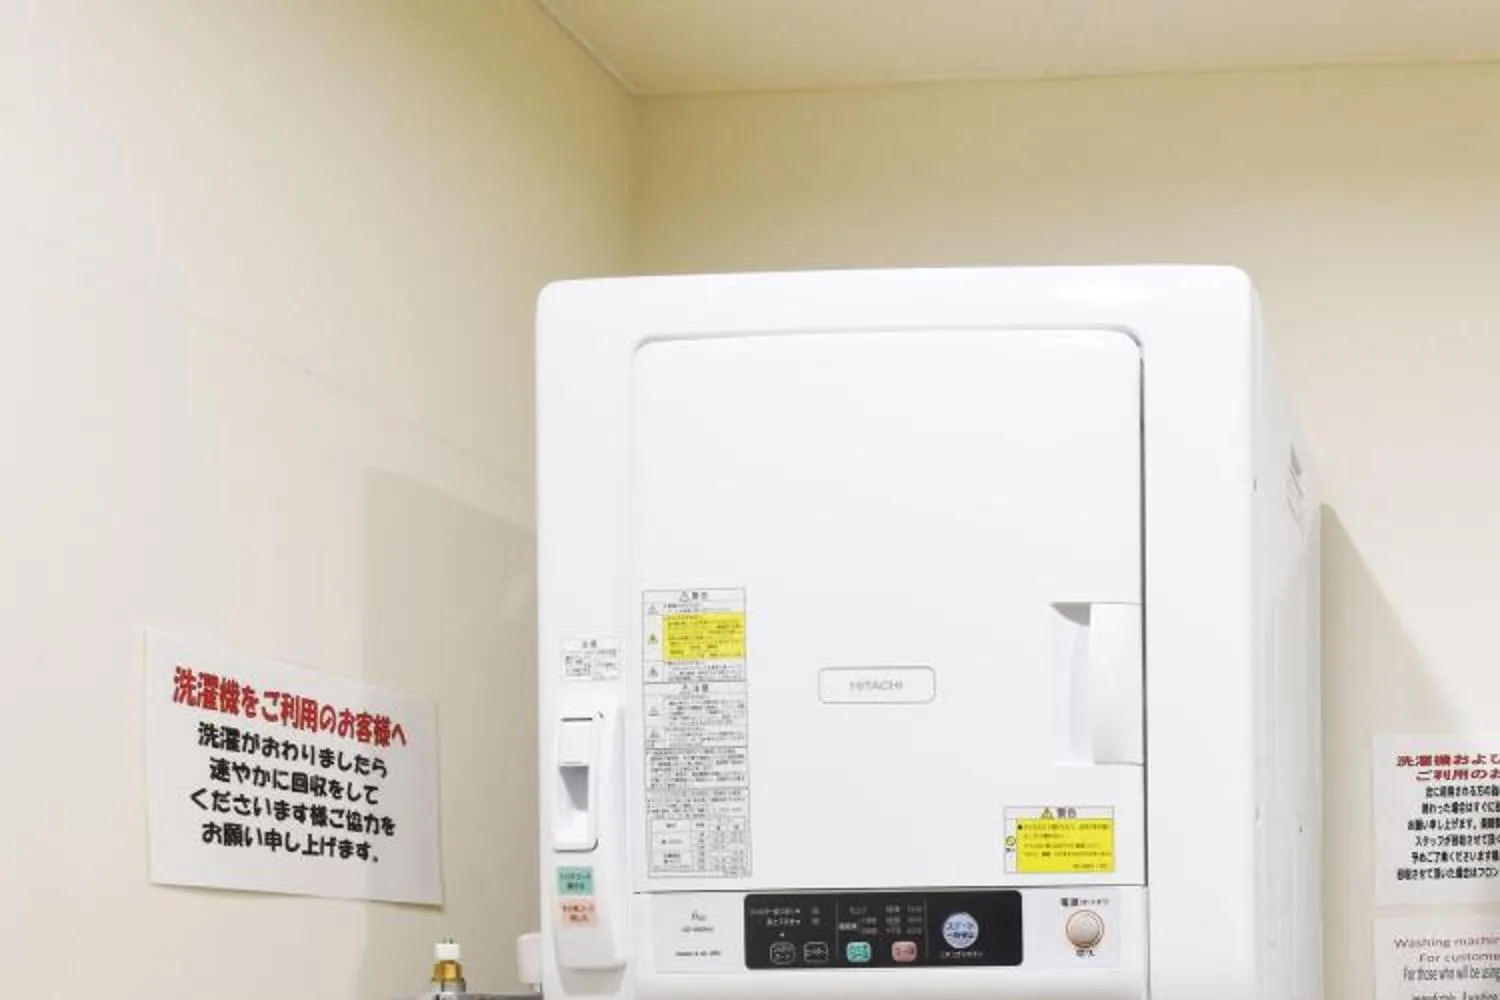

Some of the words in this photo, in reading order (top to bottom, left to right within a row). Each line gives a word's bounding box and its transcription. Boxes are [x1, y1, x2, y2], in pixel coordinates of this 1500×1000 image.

[172, 666, 408, 748] 洗濯機をご利用のお客様へ
[849, 680, 904, 691] HITACHI
[197, 721, 388, 779] 洗濯がおわりましたら
[208, 756, 380, 806] 速やかに回収をして
[189, 786, 397, 837] くださいます様ご協力を
[201, 821, 379, 863] お願い申し上げます。
[1394, 937, 1450, 949] Washing
[1419, 953, 1440, 963] For
